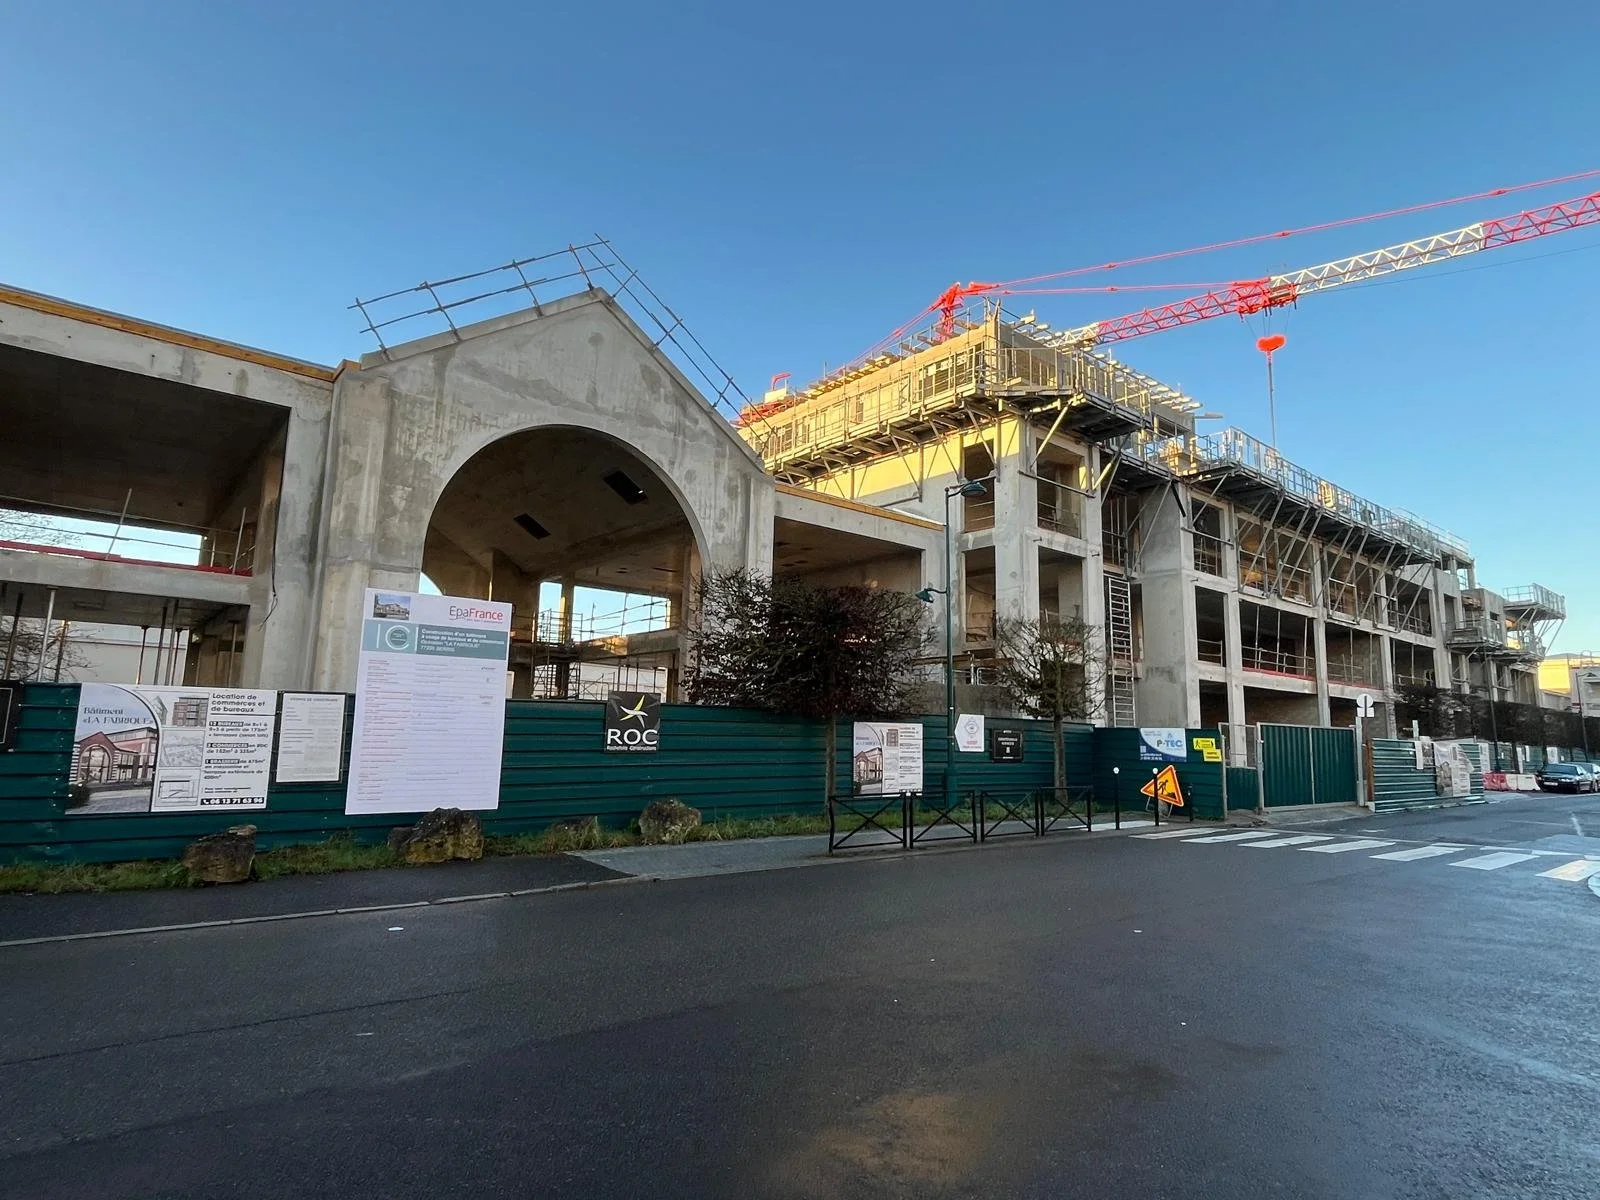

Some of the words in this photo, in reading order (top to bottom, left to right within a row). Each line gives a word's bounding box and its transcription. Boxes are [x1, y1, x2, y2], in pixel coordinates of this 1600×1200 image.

[449, 605, 503, 620] EpaFrance
[83, 706, 123, 715] Bâtiment
[606, 728, 658, 745] ROC
